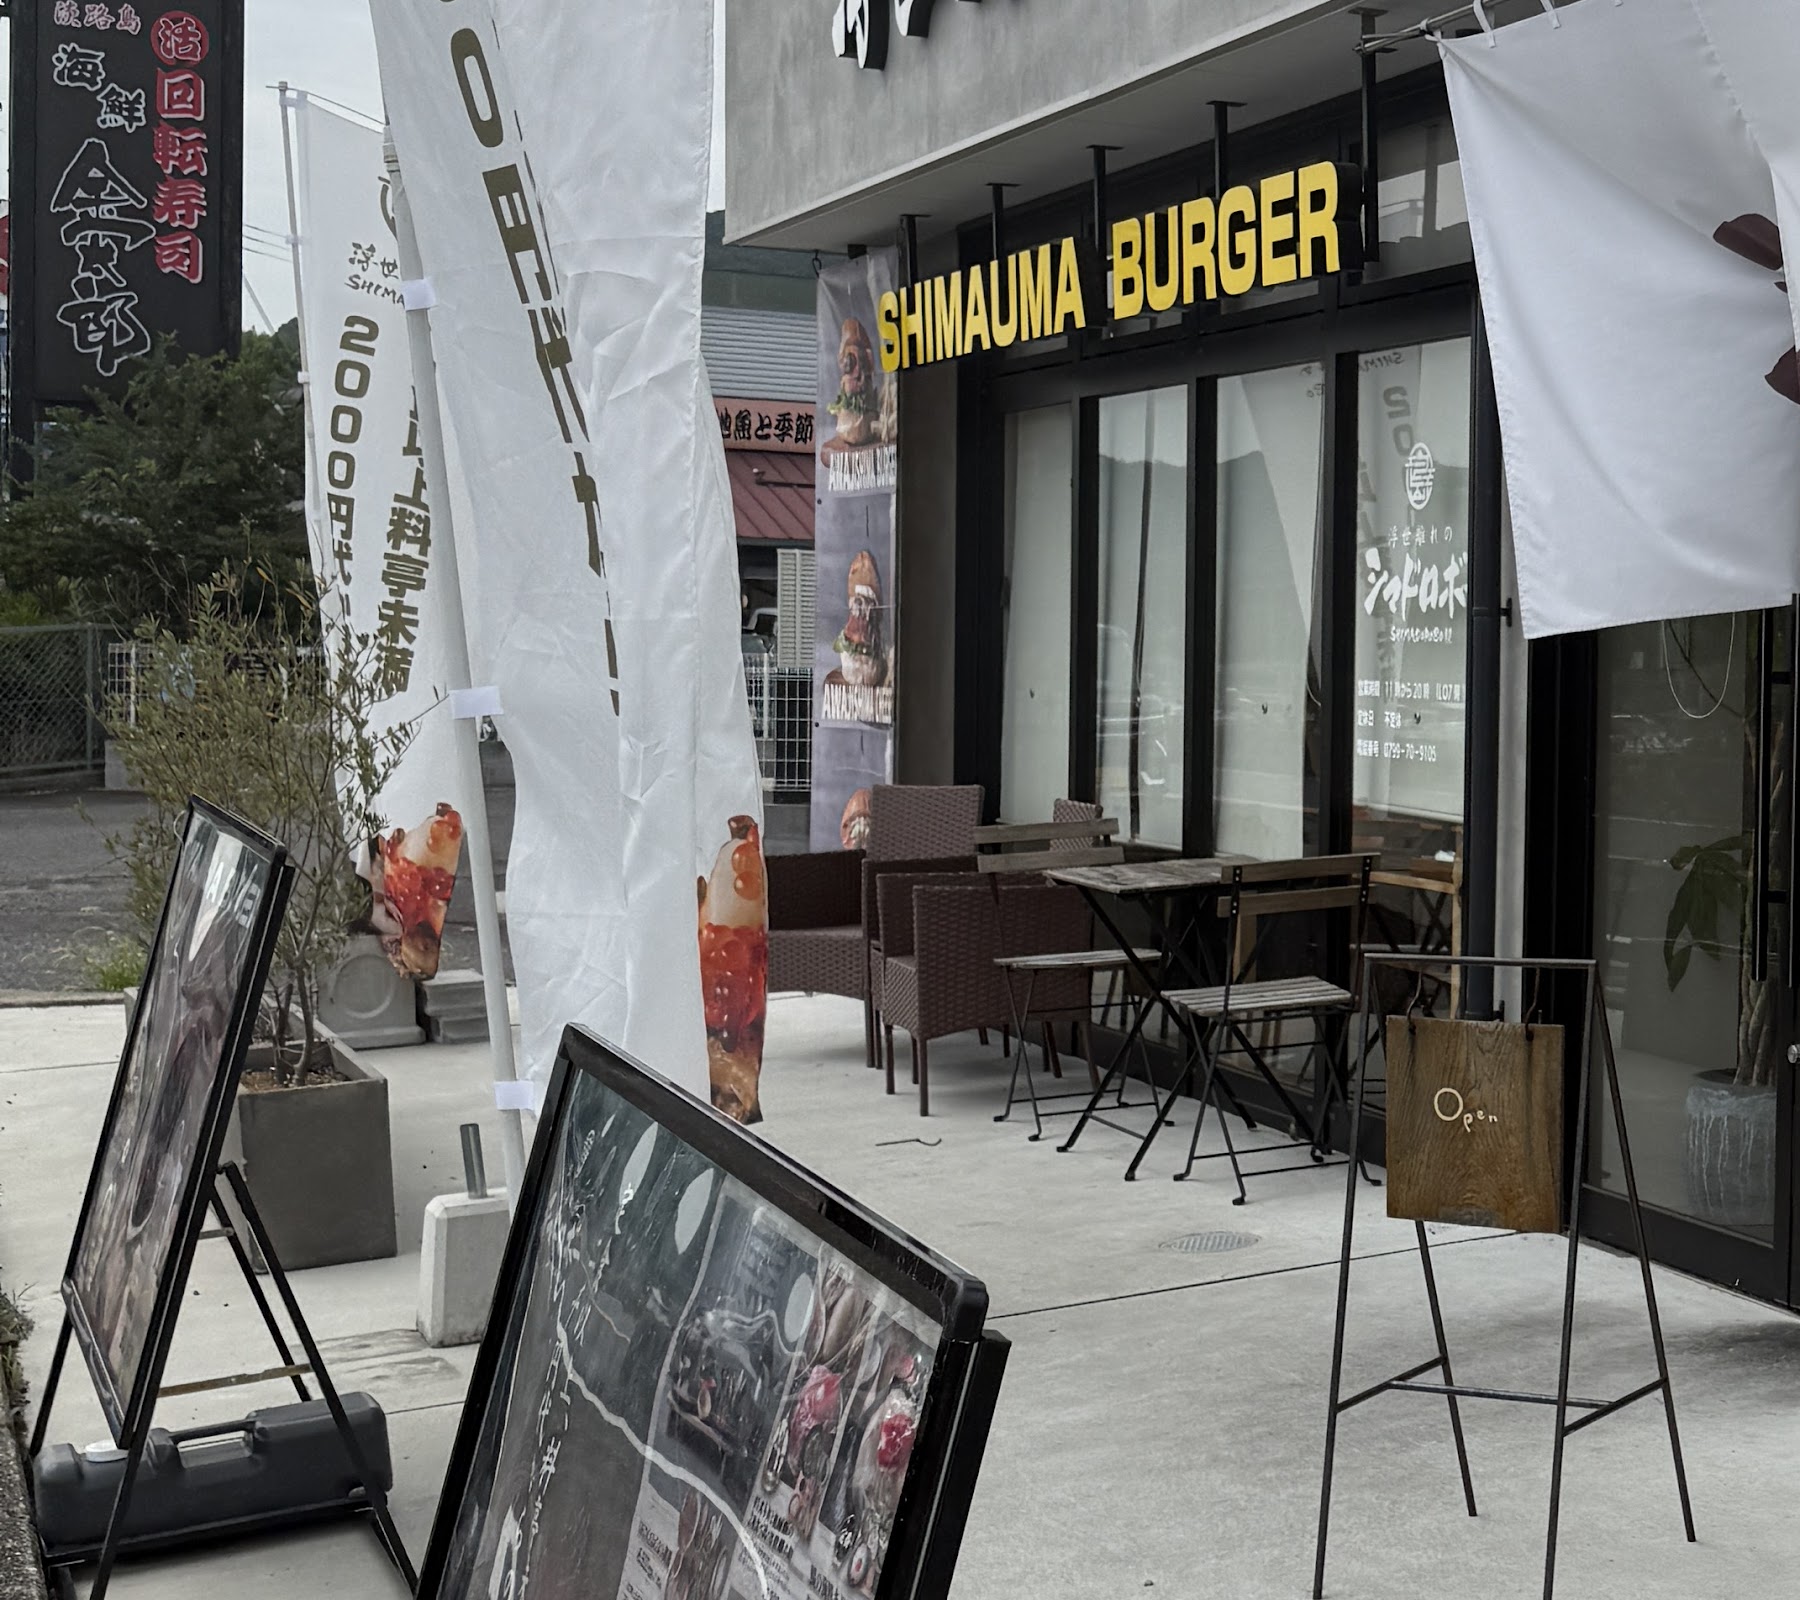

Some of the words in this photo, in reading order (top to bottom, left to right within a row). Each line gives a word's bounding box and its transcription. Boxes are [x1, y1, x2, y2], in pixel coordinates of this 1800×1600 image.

[53, 0, 142, 36] 淡路島
[52, 42, 147, 133] 海鮮
[878, 237, 1086, 373] SHIMAUMA
[1112, 161, 1340, 320] BURGER
[1433, 1087, 1499, 1133] Open
